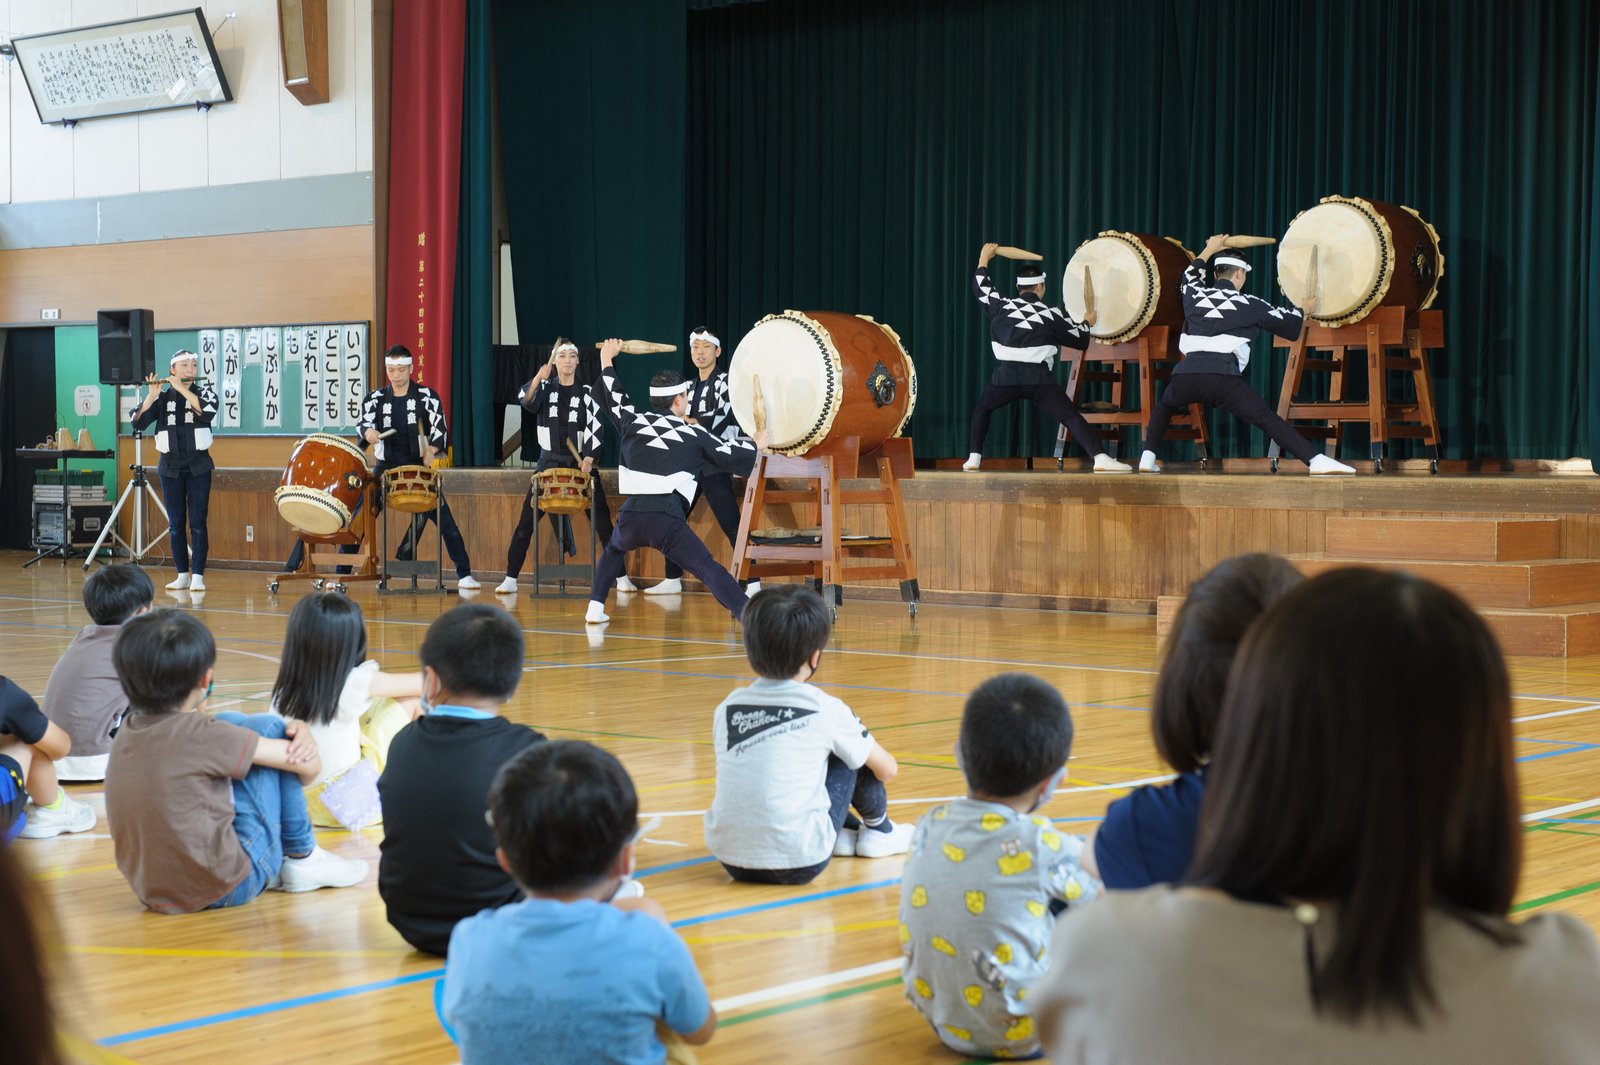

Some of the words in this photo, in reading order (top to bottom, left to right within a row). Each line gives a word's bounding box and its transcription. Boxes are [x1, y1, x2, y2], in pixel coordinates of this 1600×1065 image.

[265, 331, 279, 421] じぶんか
[286, 334, 299, 355] も
[304, 331, 318, 421] だれにで
[325, 330, 339, 419] どこでも
[347, 330, 362, 419] いつでも
[731, 709, 767, 726] Bonne
[738, 709, 783, 735] Chance!
